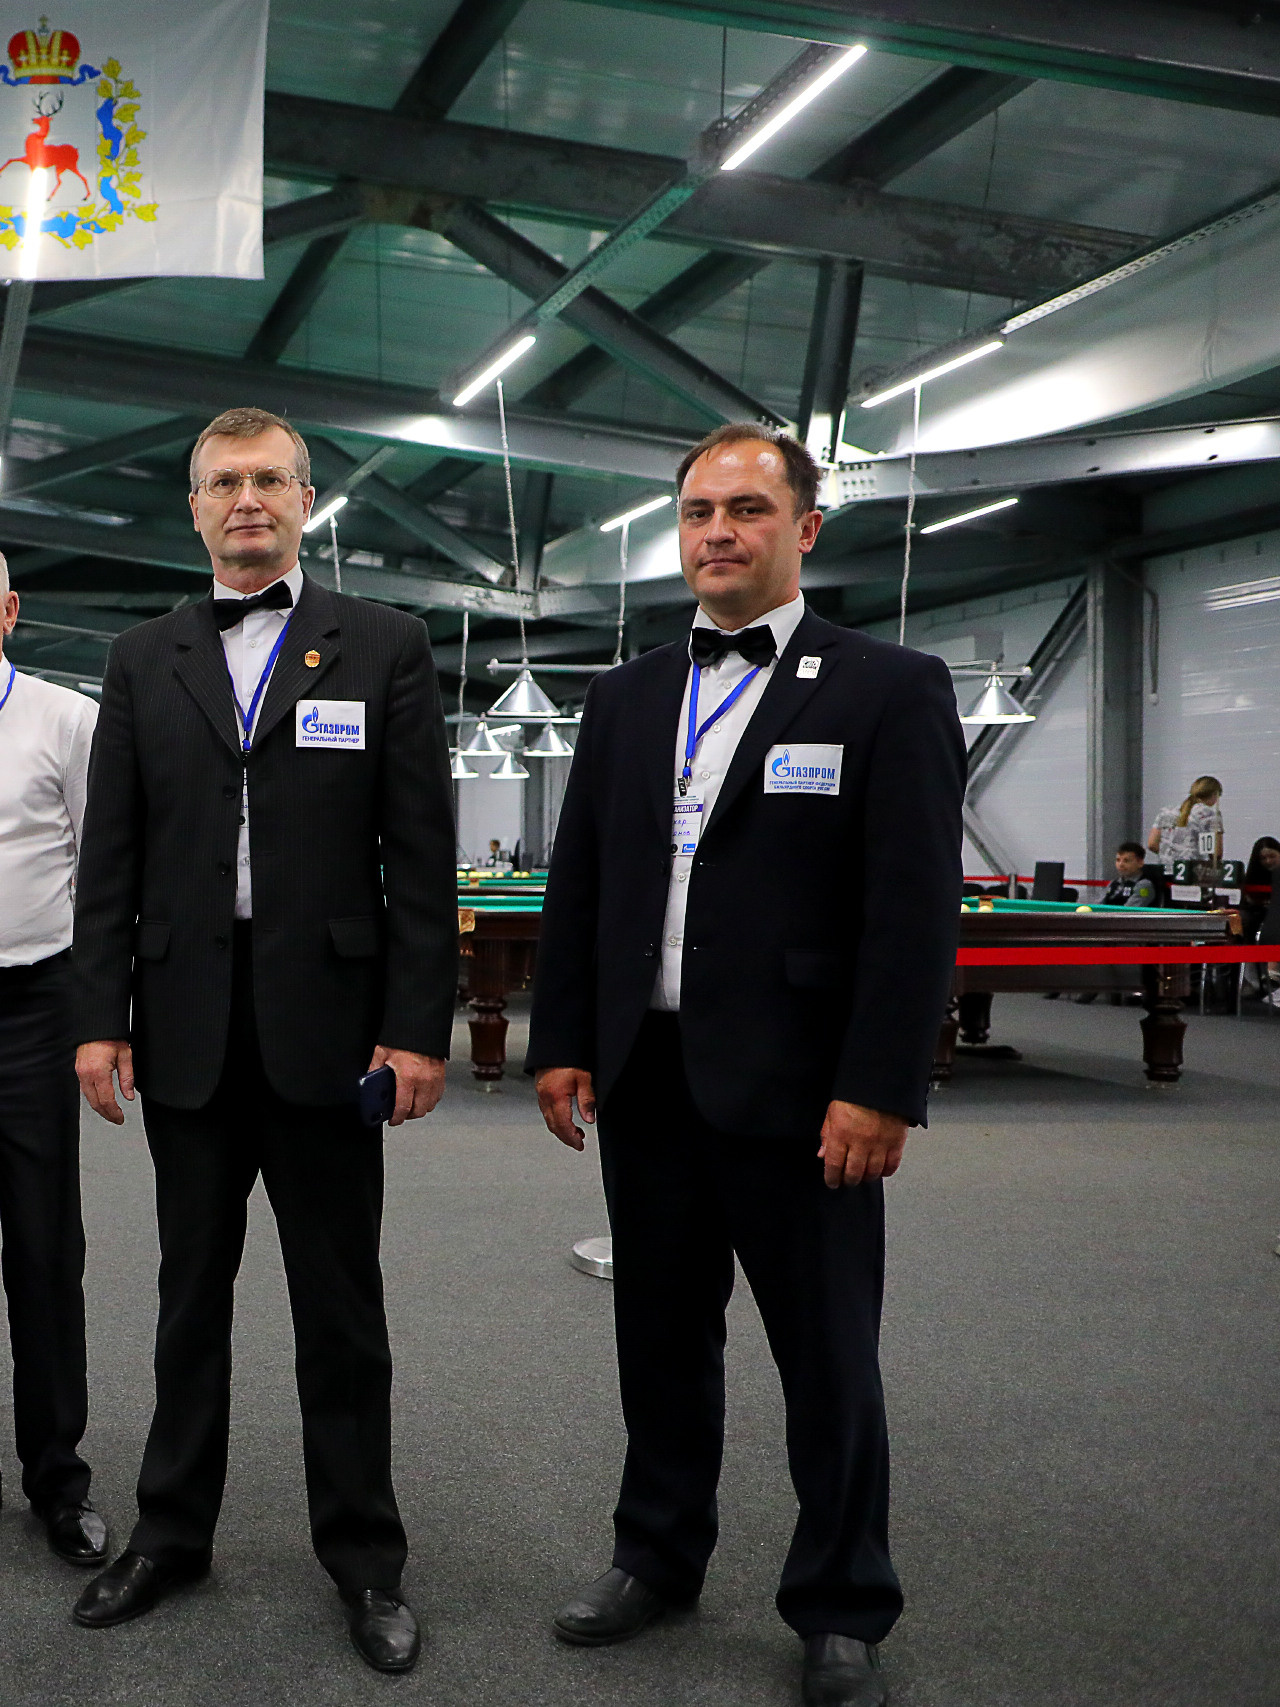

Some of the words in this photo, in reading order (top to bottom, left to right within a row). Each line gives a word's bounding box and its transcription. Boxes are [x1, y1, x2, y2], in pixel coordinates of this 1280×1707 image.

[319, 723, 360, 736] ГАЗПРОМ
[791, 766, 836, 780] ГАЗПРОМ
[1201, 834, 1213, 852] 10
[1175, 863, 1186, 880] 2
[1223, 863, 1234, 881] 2
